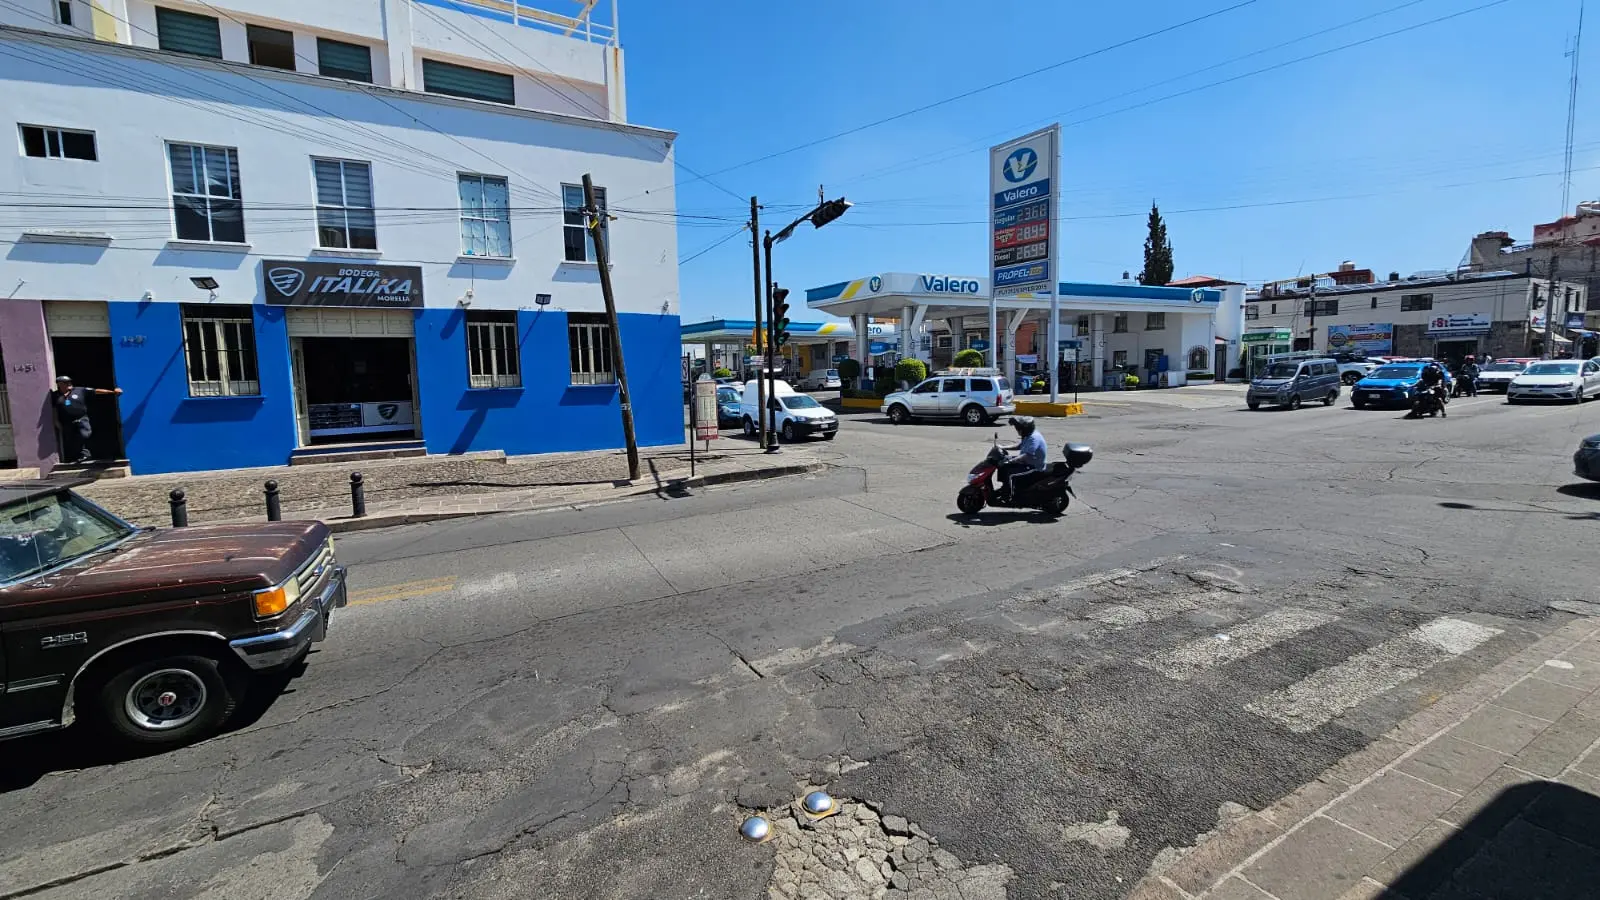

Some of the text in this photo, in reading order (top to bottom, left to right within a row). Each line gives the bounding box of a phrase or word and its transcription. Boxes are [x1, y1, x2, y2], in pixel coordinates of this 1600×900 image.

[1003, 186, 1038, 201] Valero
[995, 252, 1011, 261] Diesel
[339, 268, 380, 278] BODEGA
[308, 276, 413, 295] ITALIKA
[921, 275, 979, 293] Valero
